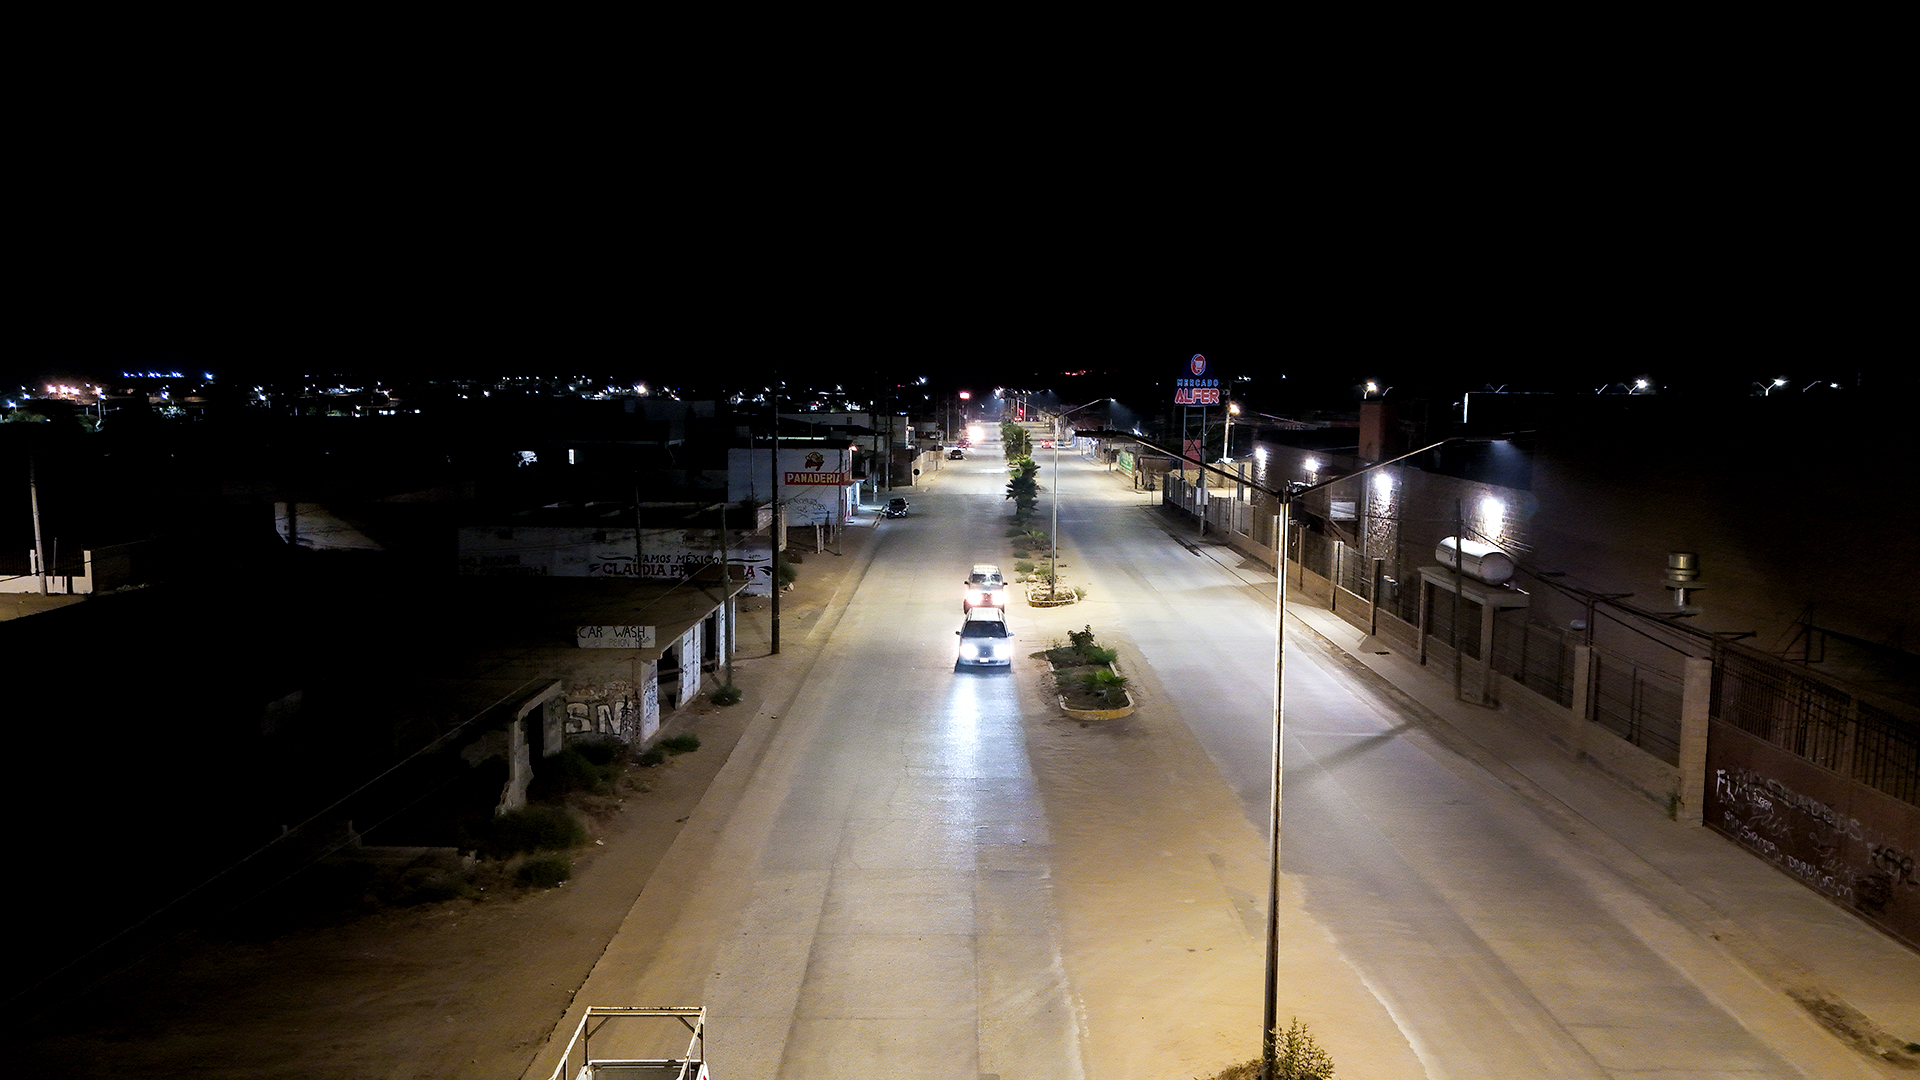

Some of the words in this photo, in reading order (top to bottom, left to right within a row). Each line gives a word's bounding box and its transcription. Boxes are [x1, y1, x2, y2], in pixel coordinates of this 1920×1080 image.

[1176, 378, 1219, 387] MERCADO
[1174, 387, 1220, 404] ALFER
[788, 473, 841, 483] PANADERIA
[602, 562, 666, 577] CLAUDIA
[578, 625, 603, 639] CAR
[613, 625, 646, 639] WASH
